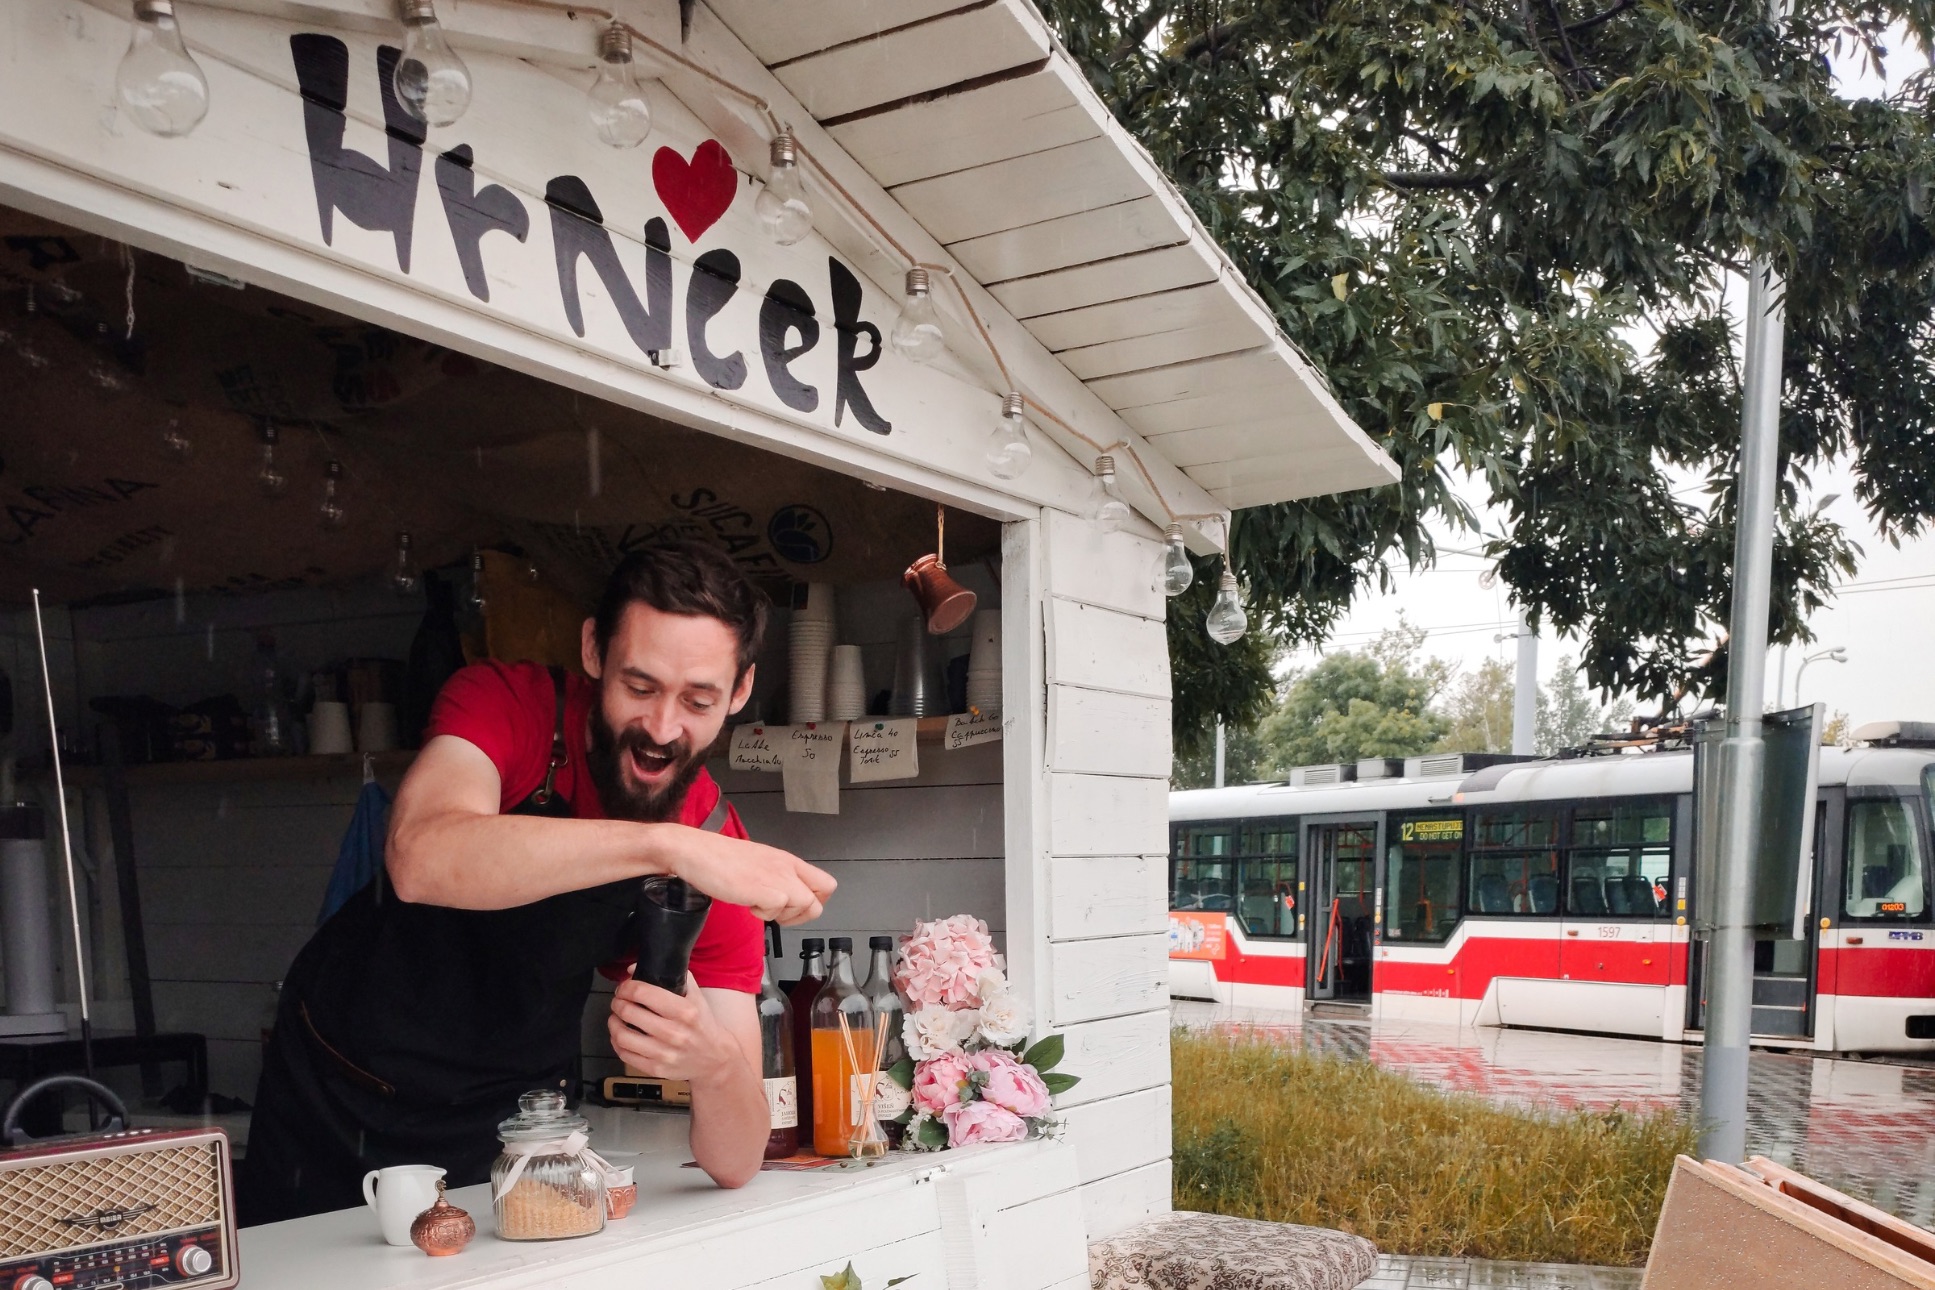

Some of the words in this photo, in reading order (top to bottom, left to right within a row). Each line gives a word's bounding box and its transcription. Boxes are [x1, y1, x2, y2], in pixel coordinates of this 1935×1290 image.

[1401, 822, 1414, 841] 12
[1429, 832, 1441, 840] NOT
[1442, 831, 1453, 840] GET
[1598, 927, 1621, 938] 1597
